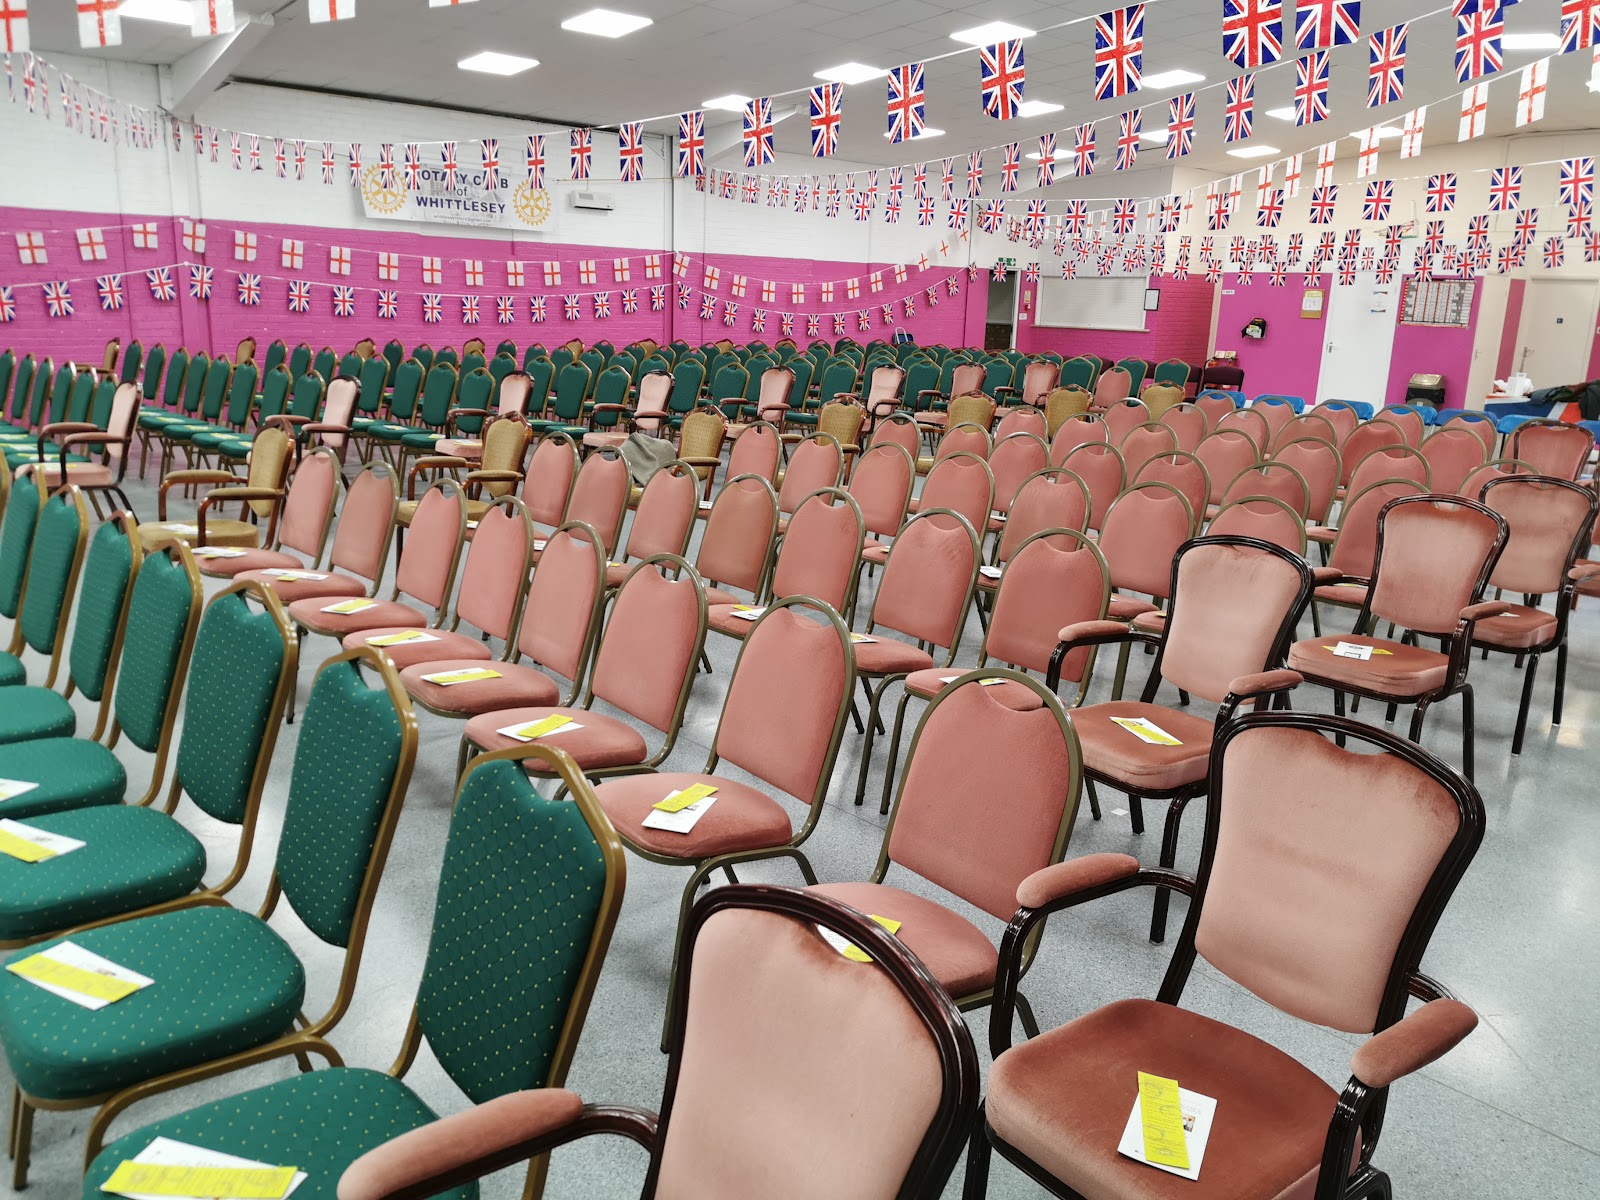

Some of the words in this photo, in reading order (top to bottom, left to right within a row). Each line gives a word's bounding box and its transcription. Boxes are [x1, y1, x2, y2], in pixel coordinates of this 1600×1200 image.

[418, 169, 468, 184] OTAY
[473, 175, 509, 189] CB
[456, 186, 468, 197] of
[415, 195, 506, 214] WHITTLESEY
